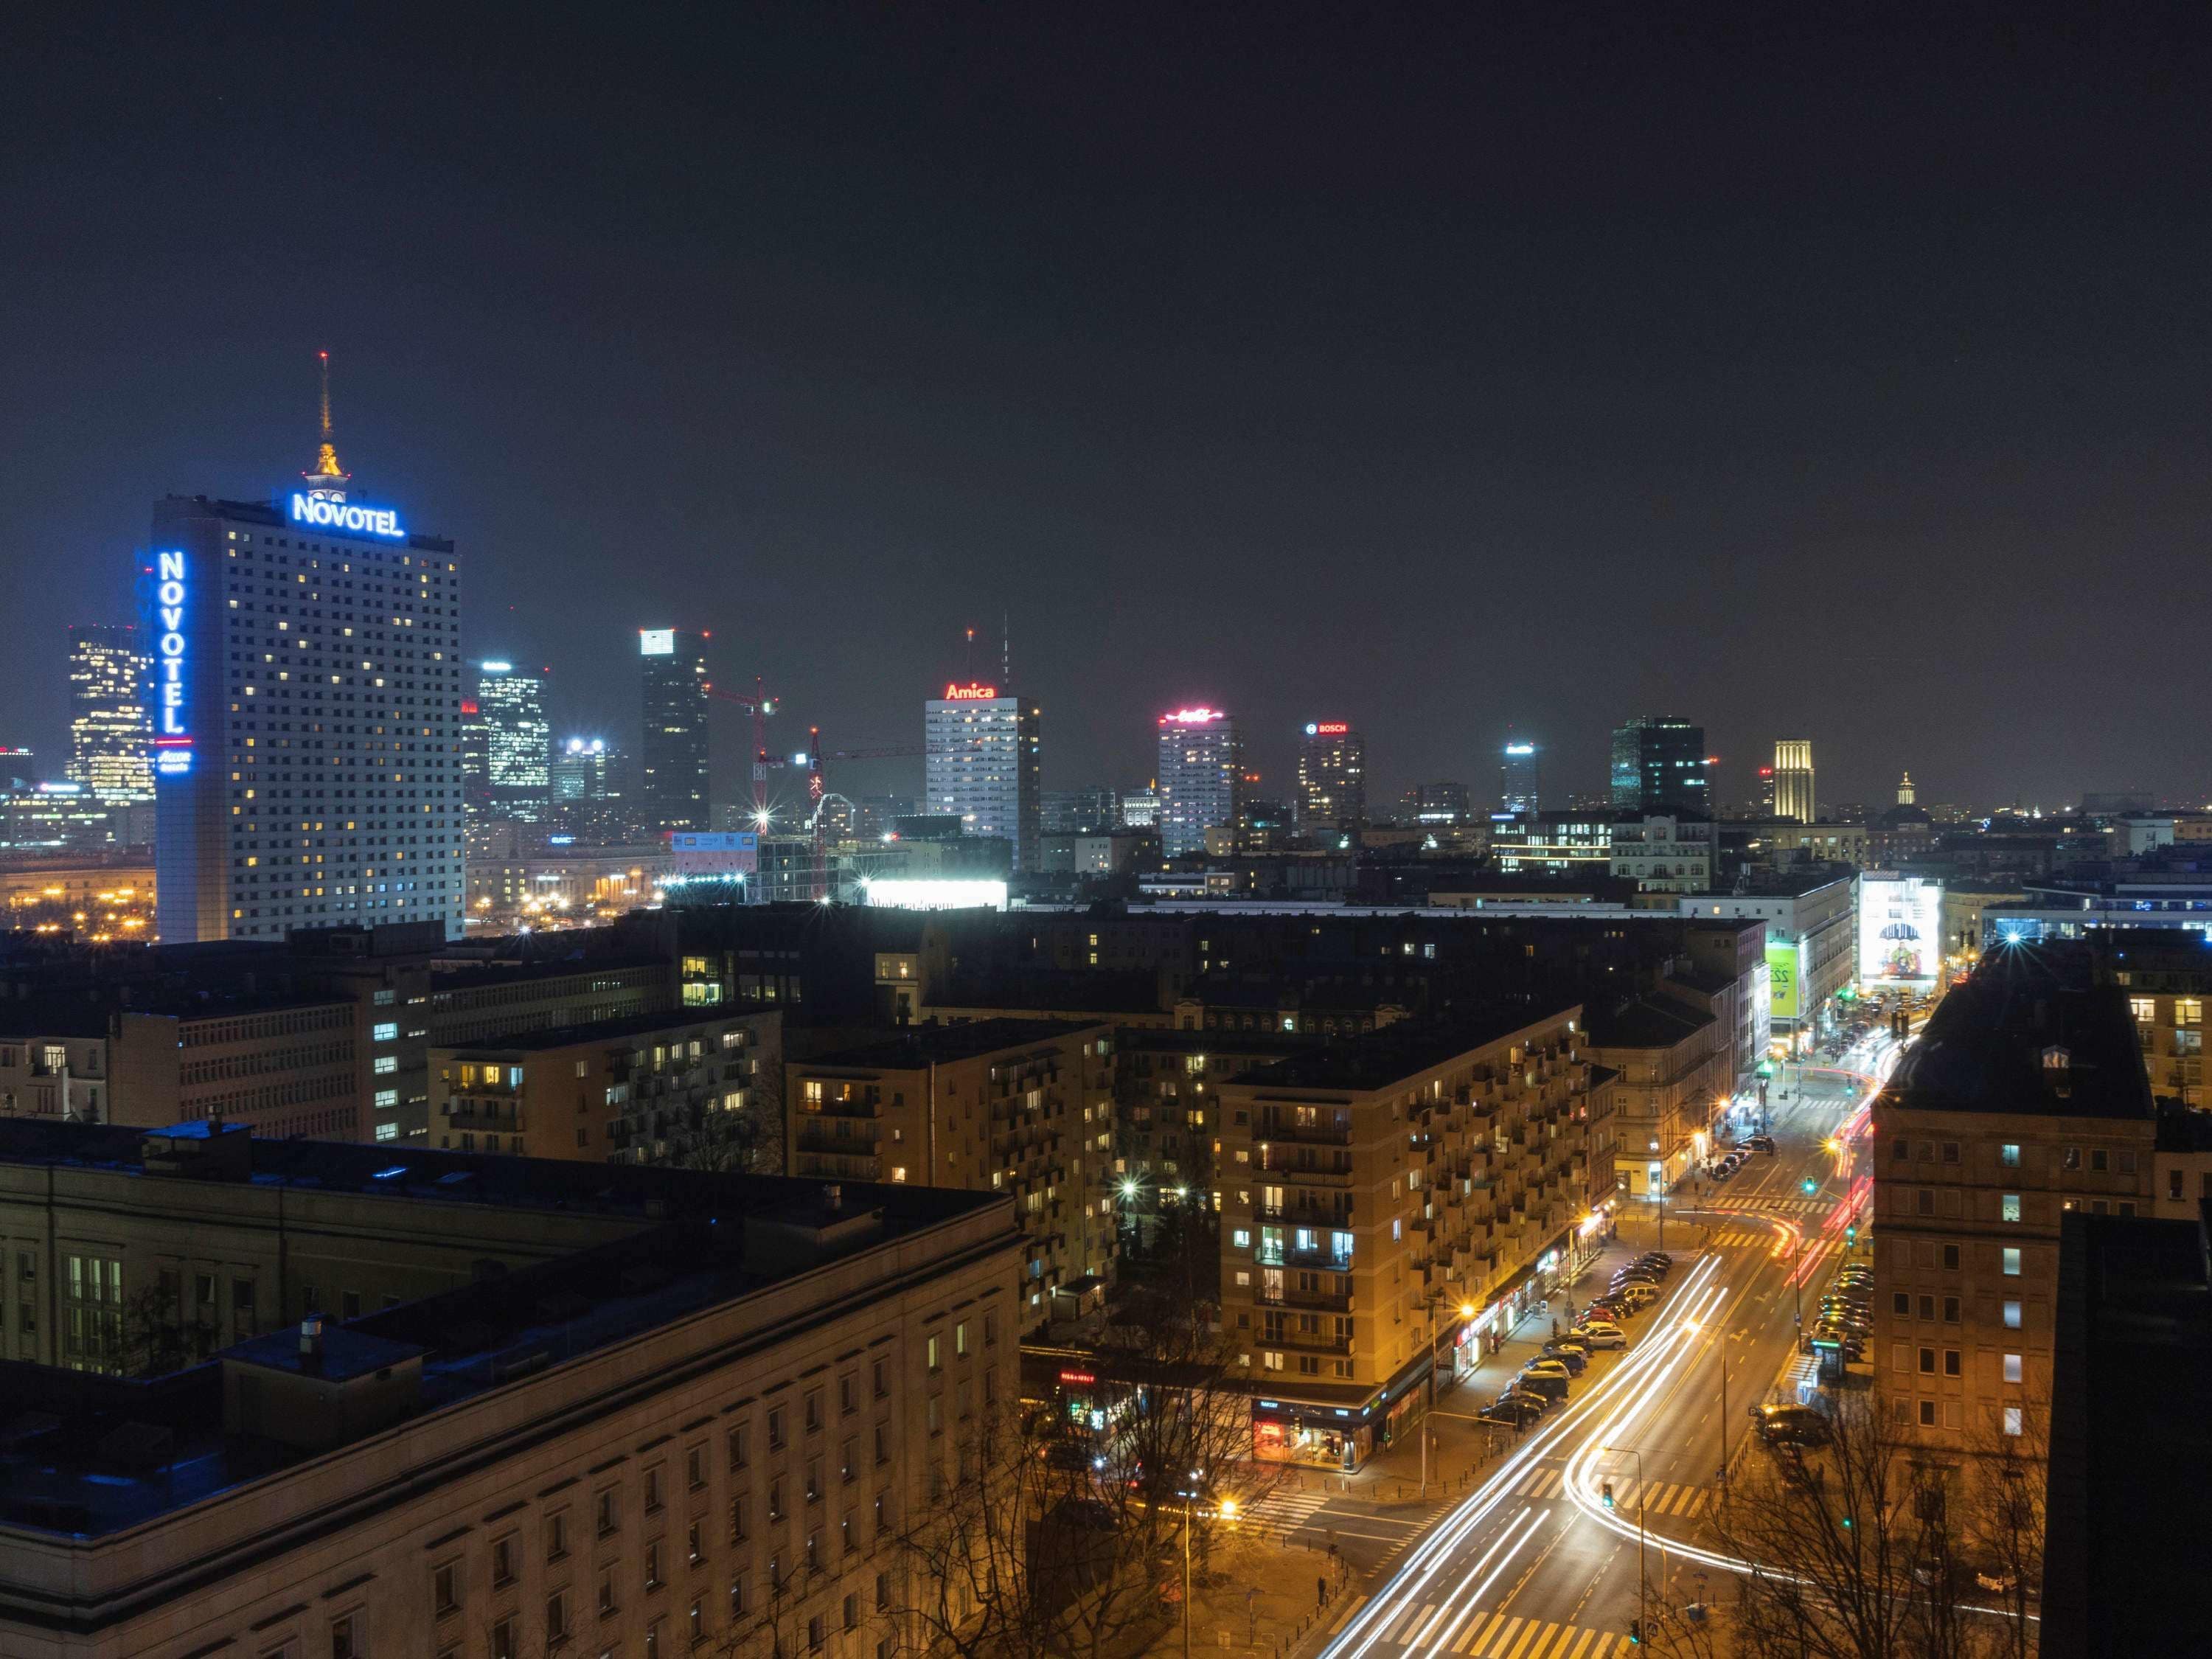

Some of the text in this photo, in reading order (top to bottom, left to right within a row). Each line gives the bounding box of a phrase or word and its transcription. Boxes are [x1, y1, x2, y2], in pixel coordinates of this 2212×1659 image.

[293, 494, 405, 537] NOVOTEL
[160, 551, 185, 734] NOVOTEL
[946, 683, 995, 700] Amica
[1318, 724, 1346, 732] BOSCH
